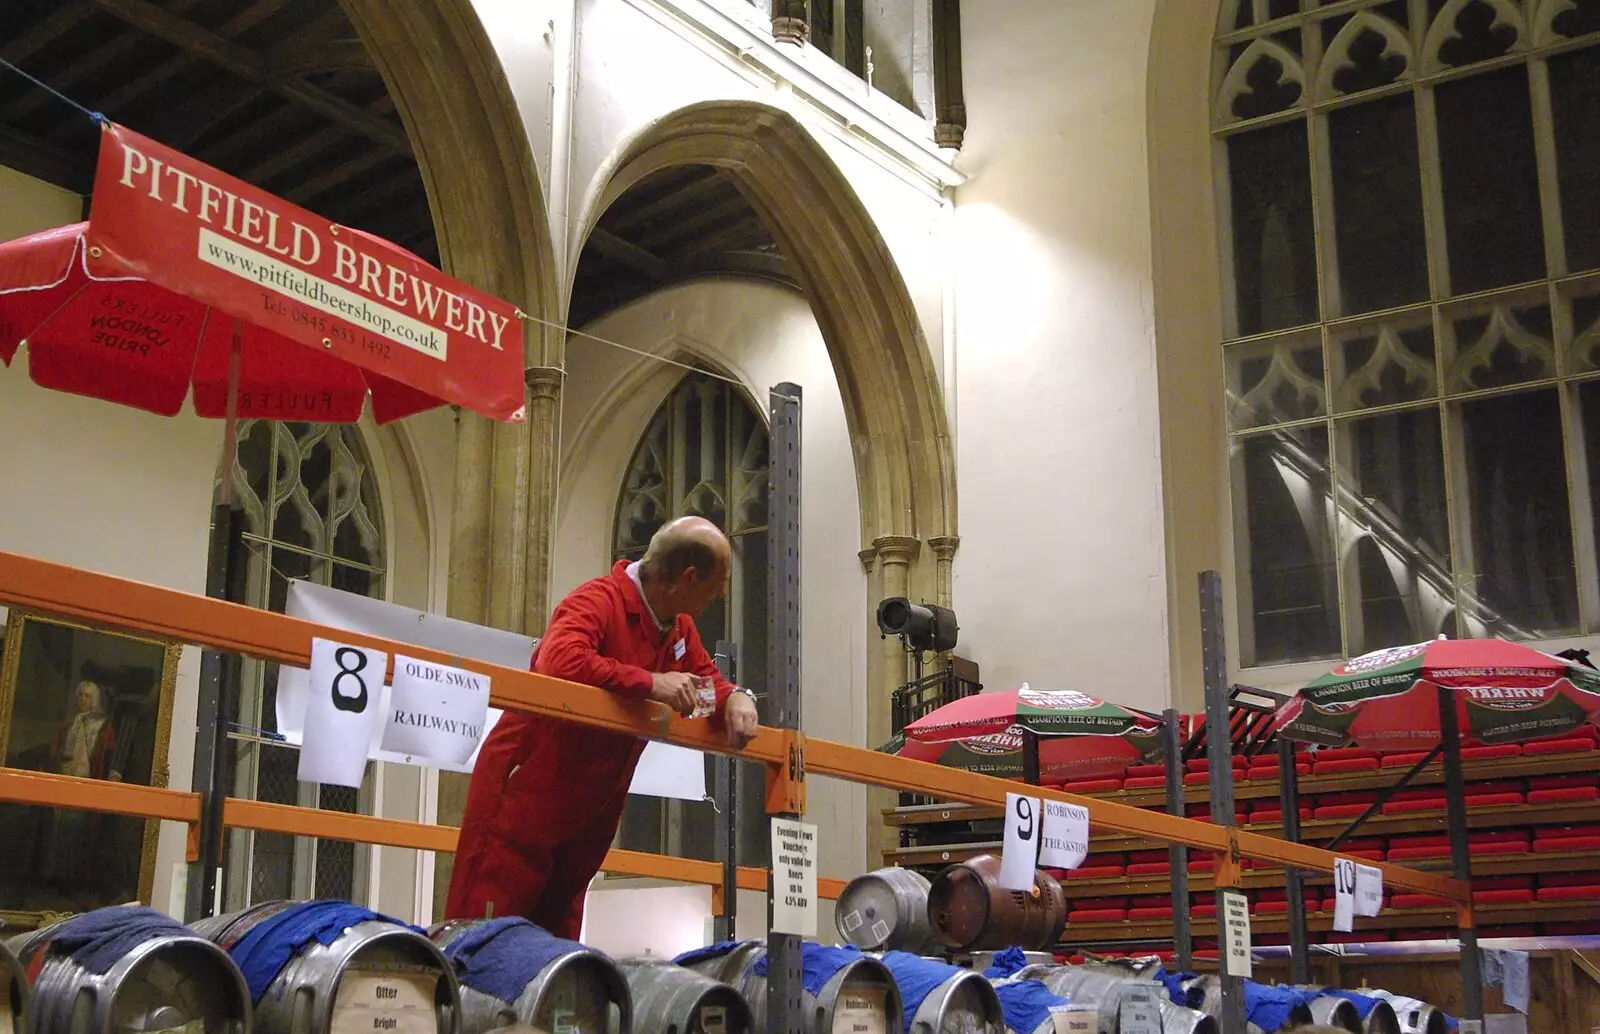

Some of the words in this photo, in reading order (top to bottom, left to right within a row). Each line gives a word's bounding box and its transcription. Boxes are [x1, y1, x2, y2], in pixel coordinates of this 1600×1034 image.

[119, 143, 321, 266] PITFIELD
[333, 240, 510, 351] BREWERY
[208, 243, 439, 352] www.pitfieldbeershop.co.uk
[261, 293, 287, 318] Tel:
[291, 308, 326, 333] 0845
[330, 322, 355, 344] 833
[361, 336, 392, 360] 1492
[331, 647, 368, 713] 8
[405, 663, 443, 683] OLDE
[446, 672, 480, 692] SWAN
[1352, 680, 1370, 690] BEER
[1371, 678, 1381, 686] OF
[394, 710, 459, 734] RAILWAY
[1067, 716, 1086, 724] BEER
[1086, 716, 1095, 724] OF
[1016, 797, 1033, 841] 9
[1046, 803, 1086, 820] ROBINSON
[777, 826, 799, 839] Evening
[1043, 837, 1087, 853] THEAKSTON
[779, 855, 790, 865] only
[790, 856, 803, 866] valid
[804, 858, 812, 867] for
[788, 869, 803, 880] Beers
[1335, 861, 1356, 895] 10
[376, 985, 397, 998] Otter
[374, 1018, 397, 1030] Bright
